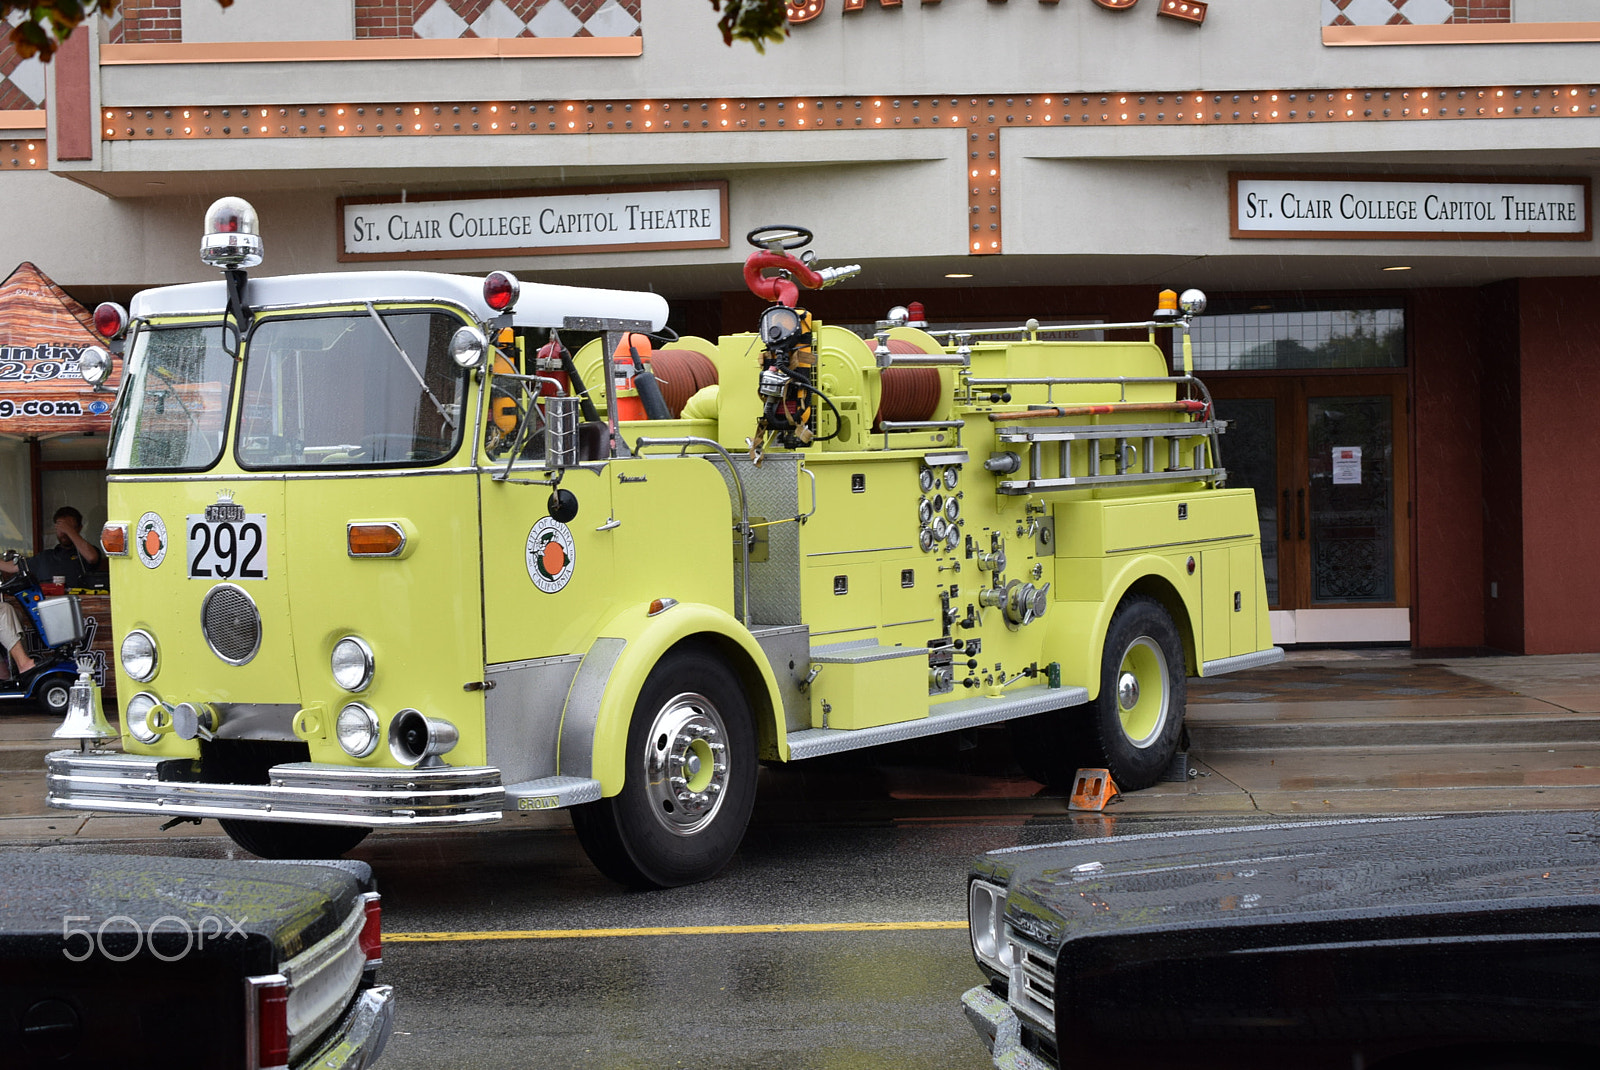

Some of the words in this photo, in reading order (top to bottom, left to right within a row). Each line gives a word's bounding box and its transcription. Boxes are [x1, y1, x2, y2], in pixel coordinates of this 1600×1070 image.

[1246, 192, 1273, 219] ST.
[1280, 193, 1333, 219] CLAIR
[1340, 194, 1417, 220] COLLEGE
[1424, 195, 1496, 220] CAPITOL
[1501, 195, 1576, 221] THEATRE
[353, 216, 380, 242] ST.
[388, 214, 442, 240] CLAIR
[449, 212, 532, 238] COLLEGE
[539, 208, 618, 234] CAPITOL
[625, 205, 711, 231] THEATRE
[190, 522, 264, 578] 292
[532, 569, 572, 592] CALIFORNIA
[520, 796, 558, 809] CROWN
